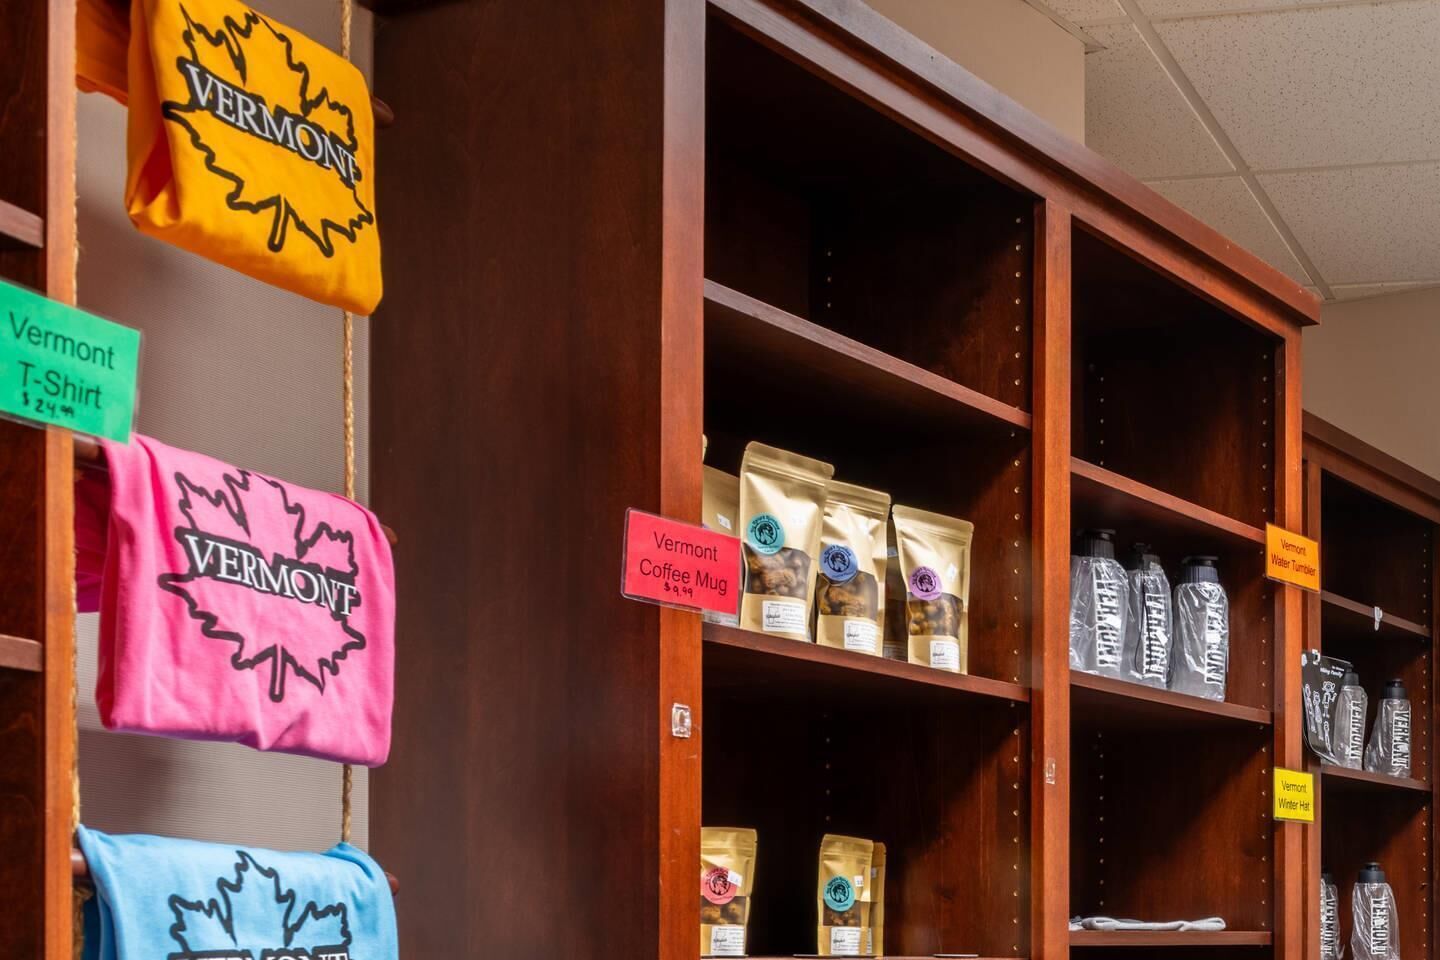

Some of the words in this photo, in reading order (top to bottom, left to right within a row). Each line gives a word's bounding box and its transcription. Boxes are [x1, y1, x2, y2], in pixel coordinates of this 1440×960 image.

[185, 62, 358, 186] VERMONT
[9, 311, 115, 371] Vermont
[18, 360, 103, 410] T-Shirt
[654, 531, 718, 562] Vermont
[1281, 538, 1307, 556] Vermont
[184, 533, 358, 616] VERMONT
[640, 558, 691, 584] Coffee
[695, 570, 728, 596] Mug
[1271, 552, 1290, 569] Water
[1291, 560, 1316, 576] Tumbler
[1281, 780, 1307, 793] Vermont
[1278, 797, 1298, 810] Winter
[1299, 800, 1310, 812] Hat
